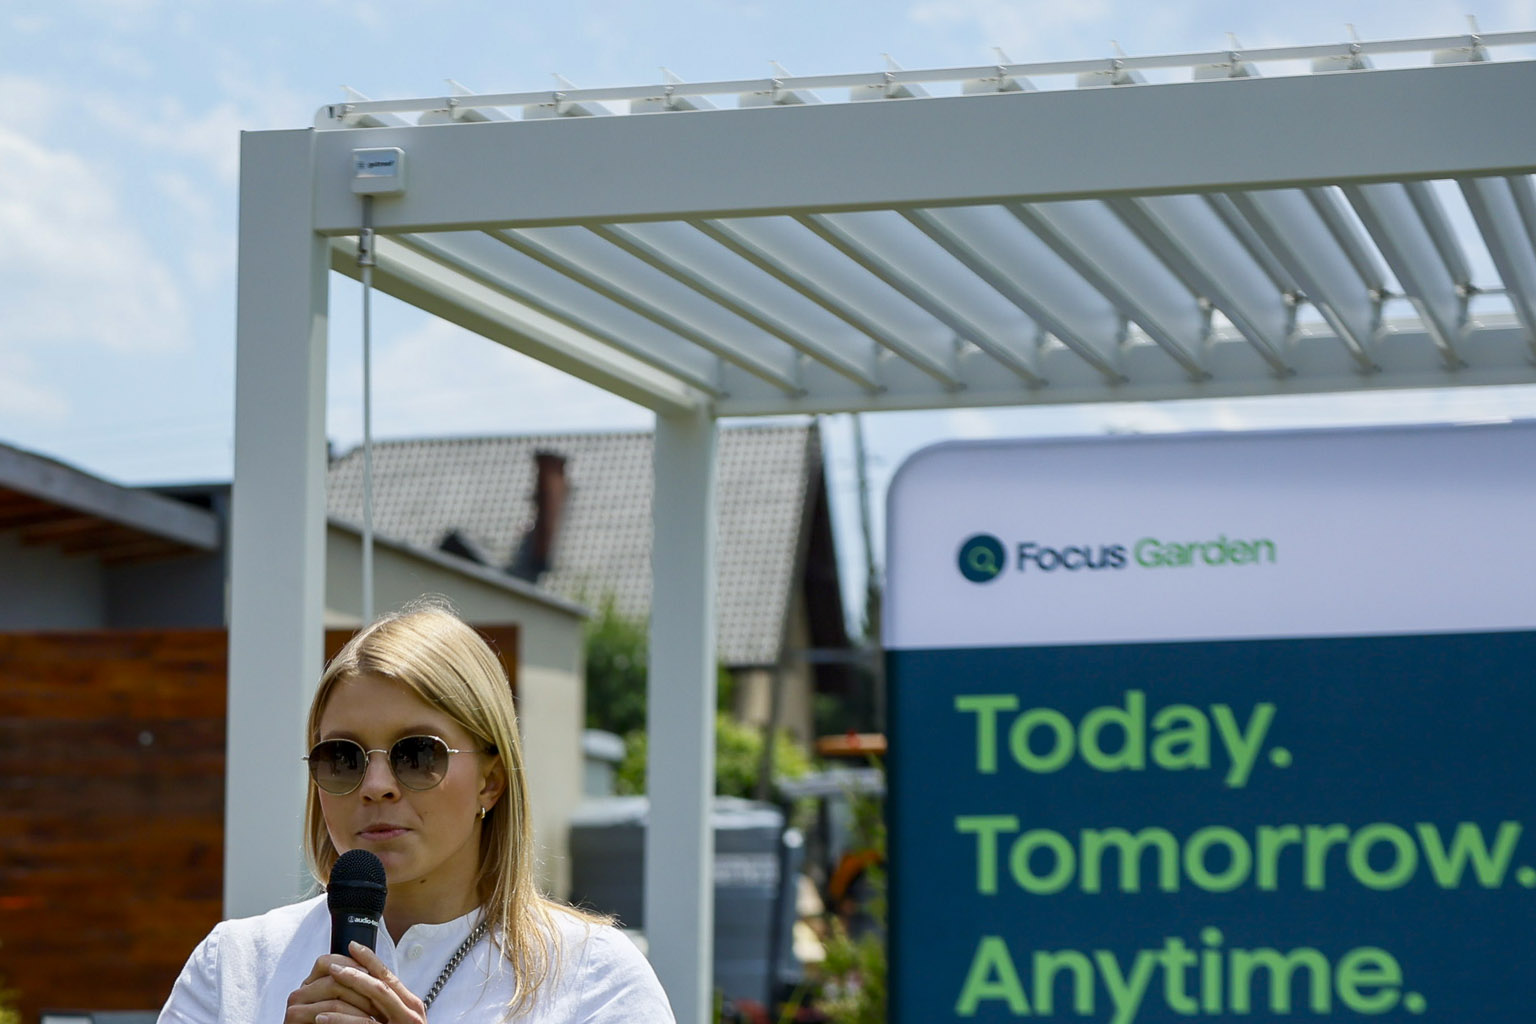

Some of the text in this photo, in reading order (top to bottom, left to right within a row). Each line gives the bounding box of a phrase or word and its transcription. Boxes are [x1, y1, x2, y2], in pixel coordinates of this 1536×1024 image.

[1016, 534, 1275, 571] Focus Garden
[955, 690, 1292, 788] Today.
[955, 815, 1536, 895] Tomorrow.
